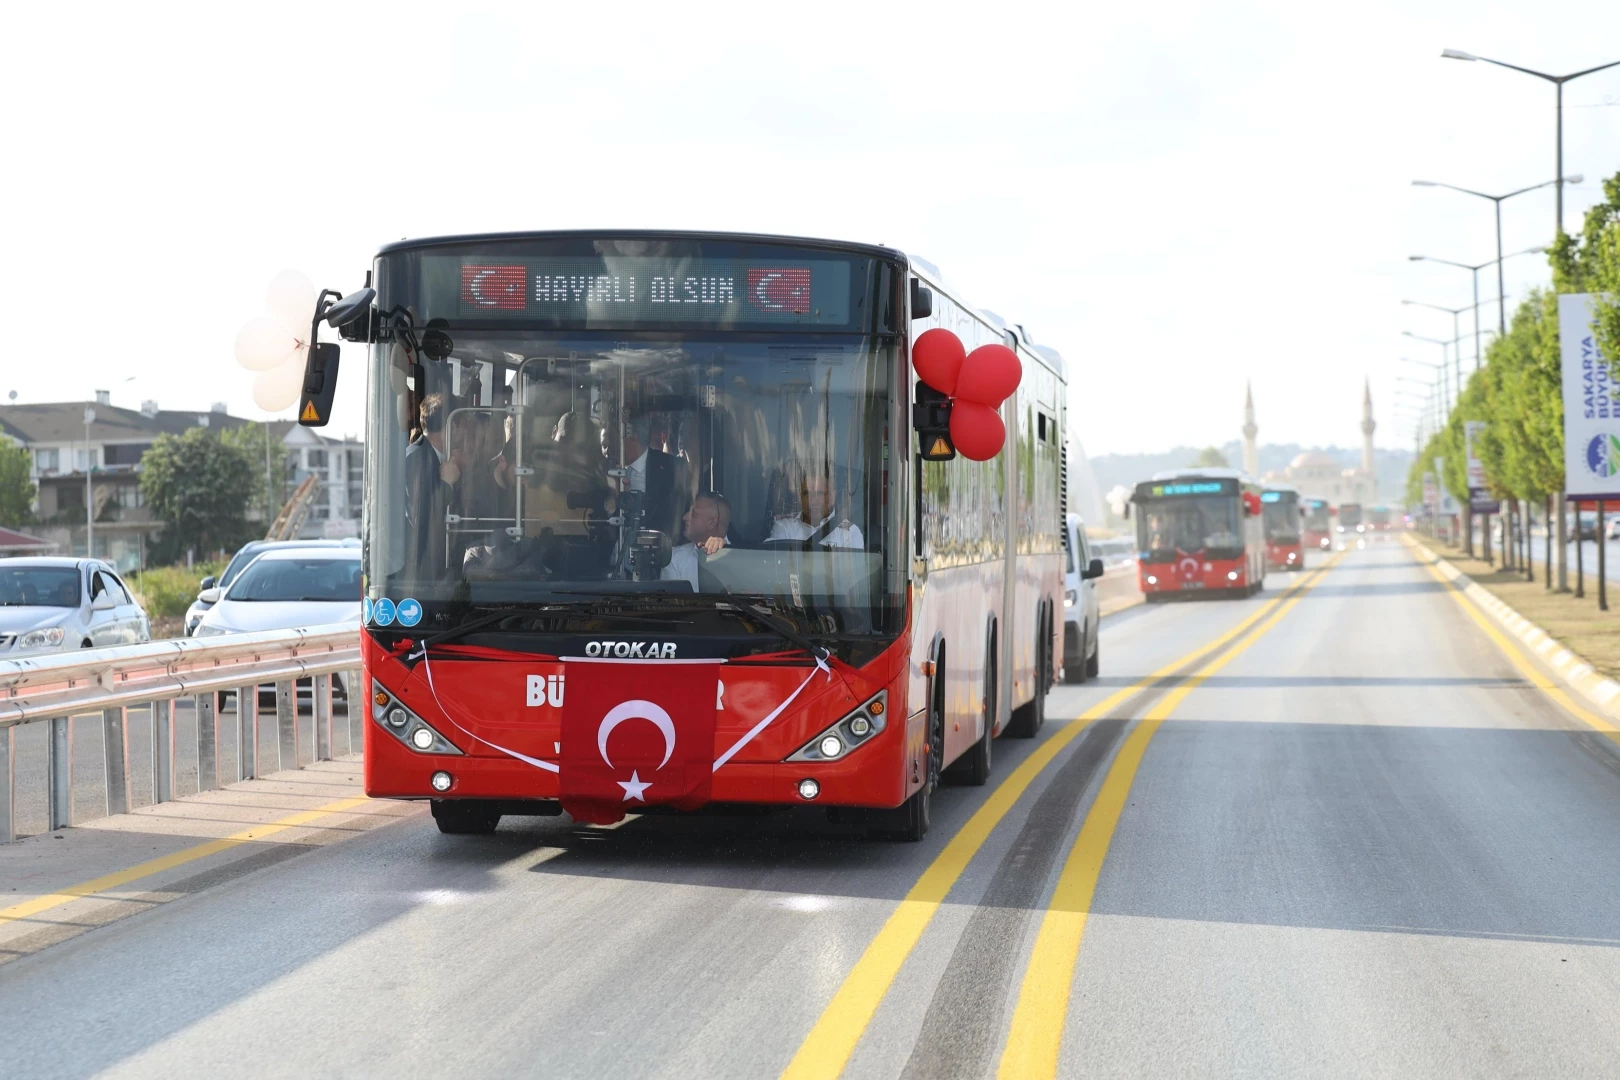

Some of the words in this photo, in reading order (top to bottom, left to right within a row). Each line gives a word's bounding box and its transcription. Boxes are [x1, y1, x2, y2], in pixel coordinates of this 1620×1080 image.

[536, 276, 635, 301] HAYIRLI
[652, 277, 733, 302] OLSUN
[1582, 336, 1595, 419] SAKARYA
[585, 641, 677, 658] OTOKAR
